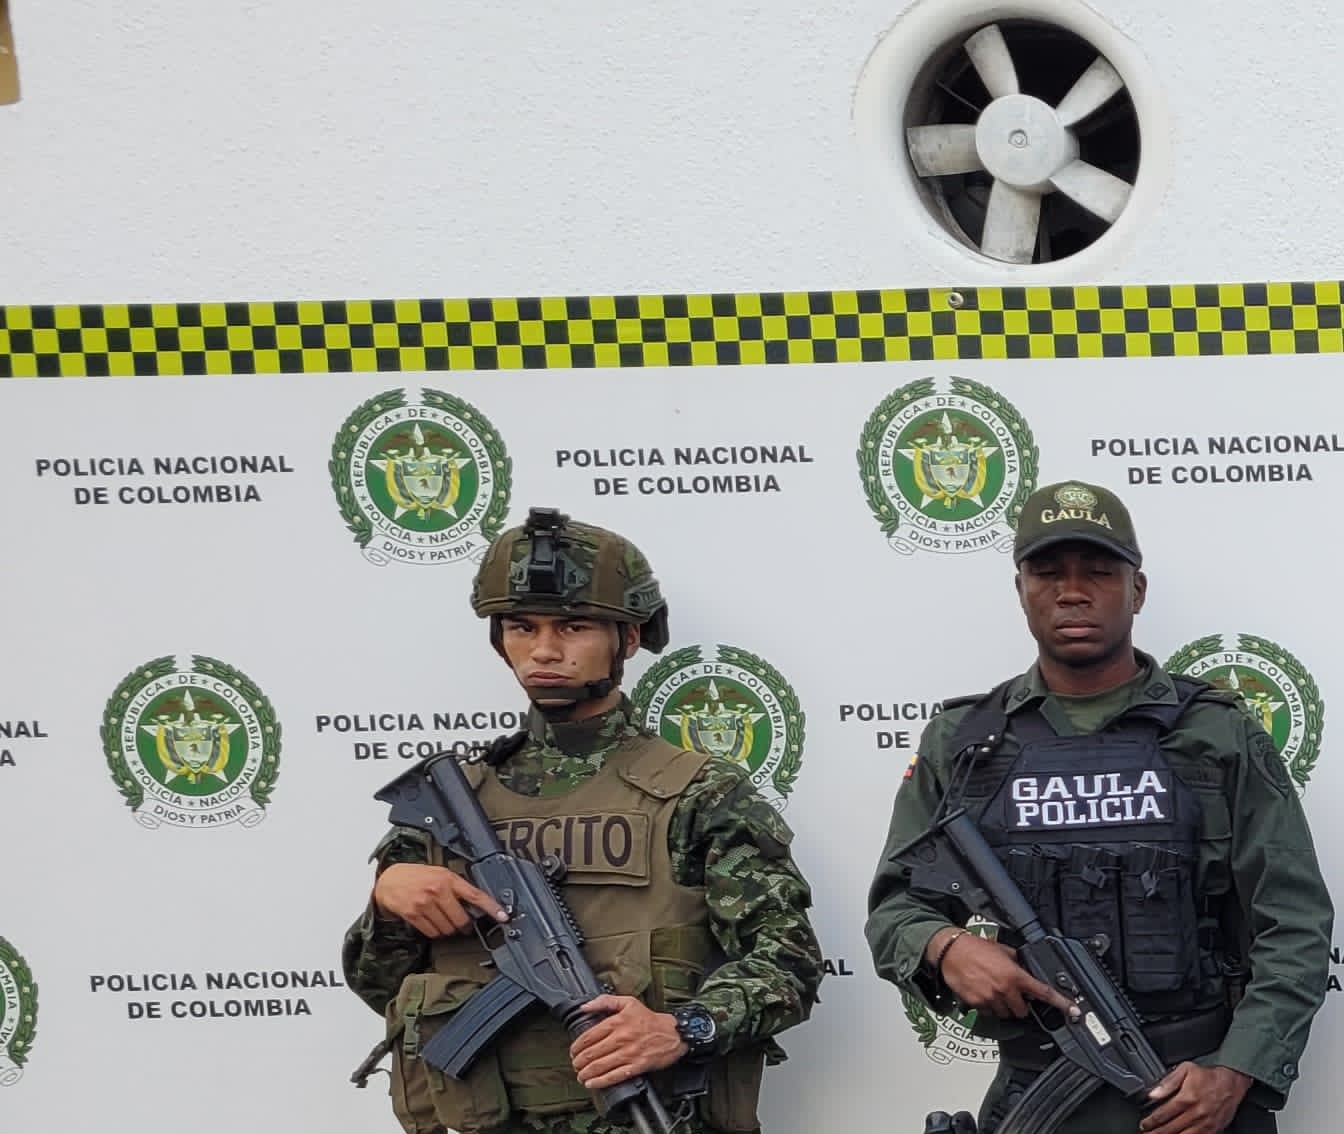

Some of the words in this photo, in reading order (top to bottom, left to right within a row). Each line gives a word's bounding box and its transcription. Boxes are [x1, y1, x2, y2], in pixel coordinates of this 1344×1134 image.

[556, 449, 664, 467] POLICIA
[674, 446, 813, 465] NACIONAL
[1092, 438, 1198, 456] POLICIA
[36, 458, 144, 476] POLICIA
[154, 456, 293, 474] NACIONAL
[1128, 467, 1162, 484] DE
[1172, 464, 1312, 483] COLOMBIA
[75, 488, 108, 504] DE
[119, 485, 261, 504] COLOMBIA
[594, 478, 628, 495] DE
[638, 475, 780, 494] COLOMBIA
[1041, 509, 1113, 530] GAULA
[178, 675, 196, 684] DE
[215, 682, 257, 749] COLOMBIA
[316, 714, 424, 732] POLICIA
[877, 732, 910, 748] DE
[354, 743, 388, 760] DE
[197, 764, 258, 806] NACIONAL
[1012, 770, 1167, 801] GAULA
[200, 804, 245, 823] PATRIA
[1015, 795, 1165, 827] POLICIA
[90, 974, 197, 992] POLICIA
[206, 971, 344, 989] NACIONAL
[128, 1002, 161, 1019] DE
[171, 999, 311, 1018] COLOMBIA
